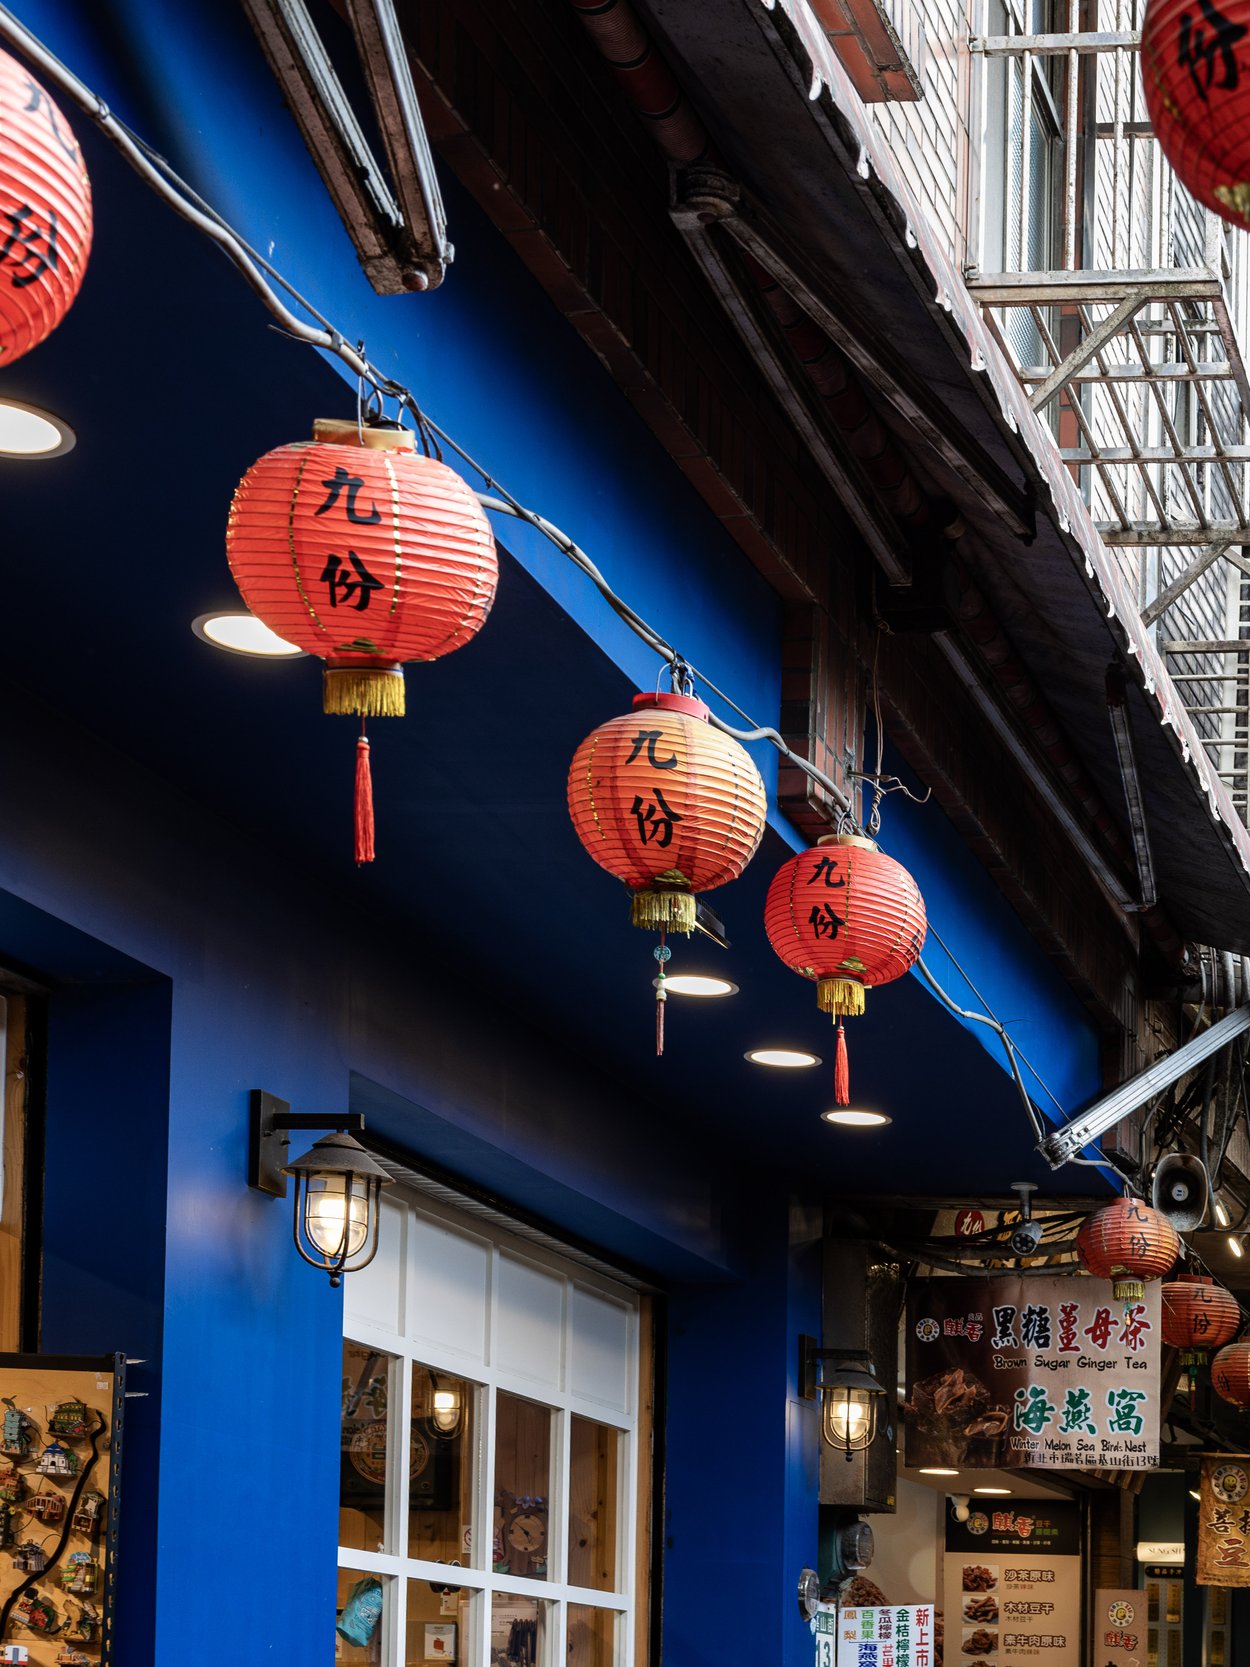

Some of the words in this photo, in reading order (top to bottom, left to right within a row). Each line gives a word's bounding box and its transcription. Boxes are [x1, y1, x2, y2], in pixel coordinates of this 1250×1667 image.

[313, 467, 385, 612] 九份
[625, 730, 683, 848] 九份
[806, 857, 846, 940] 九份
[1127, 1205, 1151, 1259] 九份
[992, 1303, 1151, 1353] 黑糖薑母茶
[1192, 1287, 1214, 1334] 九份
[993, 1355, 1027, 1370] Brown
[1034, 1356, 1070, 1371] Sugar
[1077, 1356, 1117, 1371] Ginger
[1124, 1357, 1148, 1370] Tea
[1014, 1387, 1146, 1435] 海燕窩
[1010, 1438, 1040, 1451] Winter
[1045, 1440, 1071, 1451] Melon
[1077, 1440, 1095, 1452] Sea
[1124, 1440, 1147, 1453] Nest
[1004, 1569, 1055, 1582] 沙茶原味
[862, 1609, 874, 1640] 百香果
[878, 1608, 892, 1640] 冬瓜檸檬
[1004, 1602, 1055, 1615] 木材豆干
[816, 1639, 831, 1667] 13
[896, 1608, 910, 1667] 金桔檸檬
[915, 1608, 929, 1667] 新上市
[1004, 1635, 1067, 1648] 素牛肉原味
